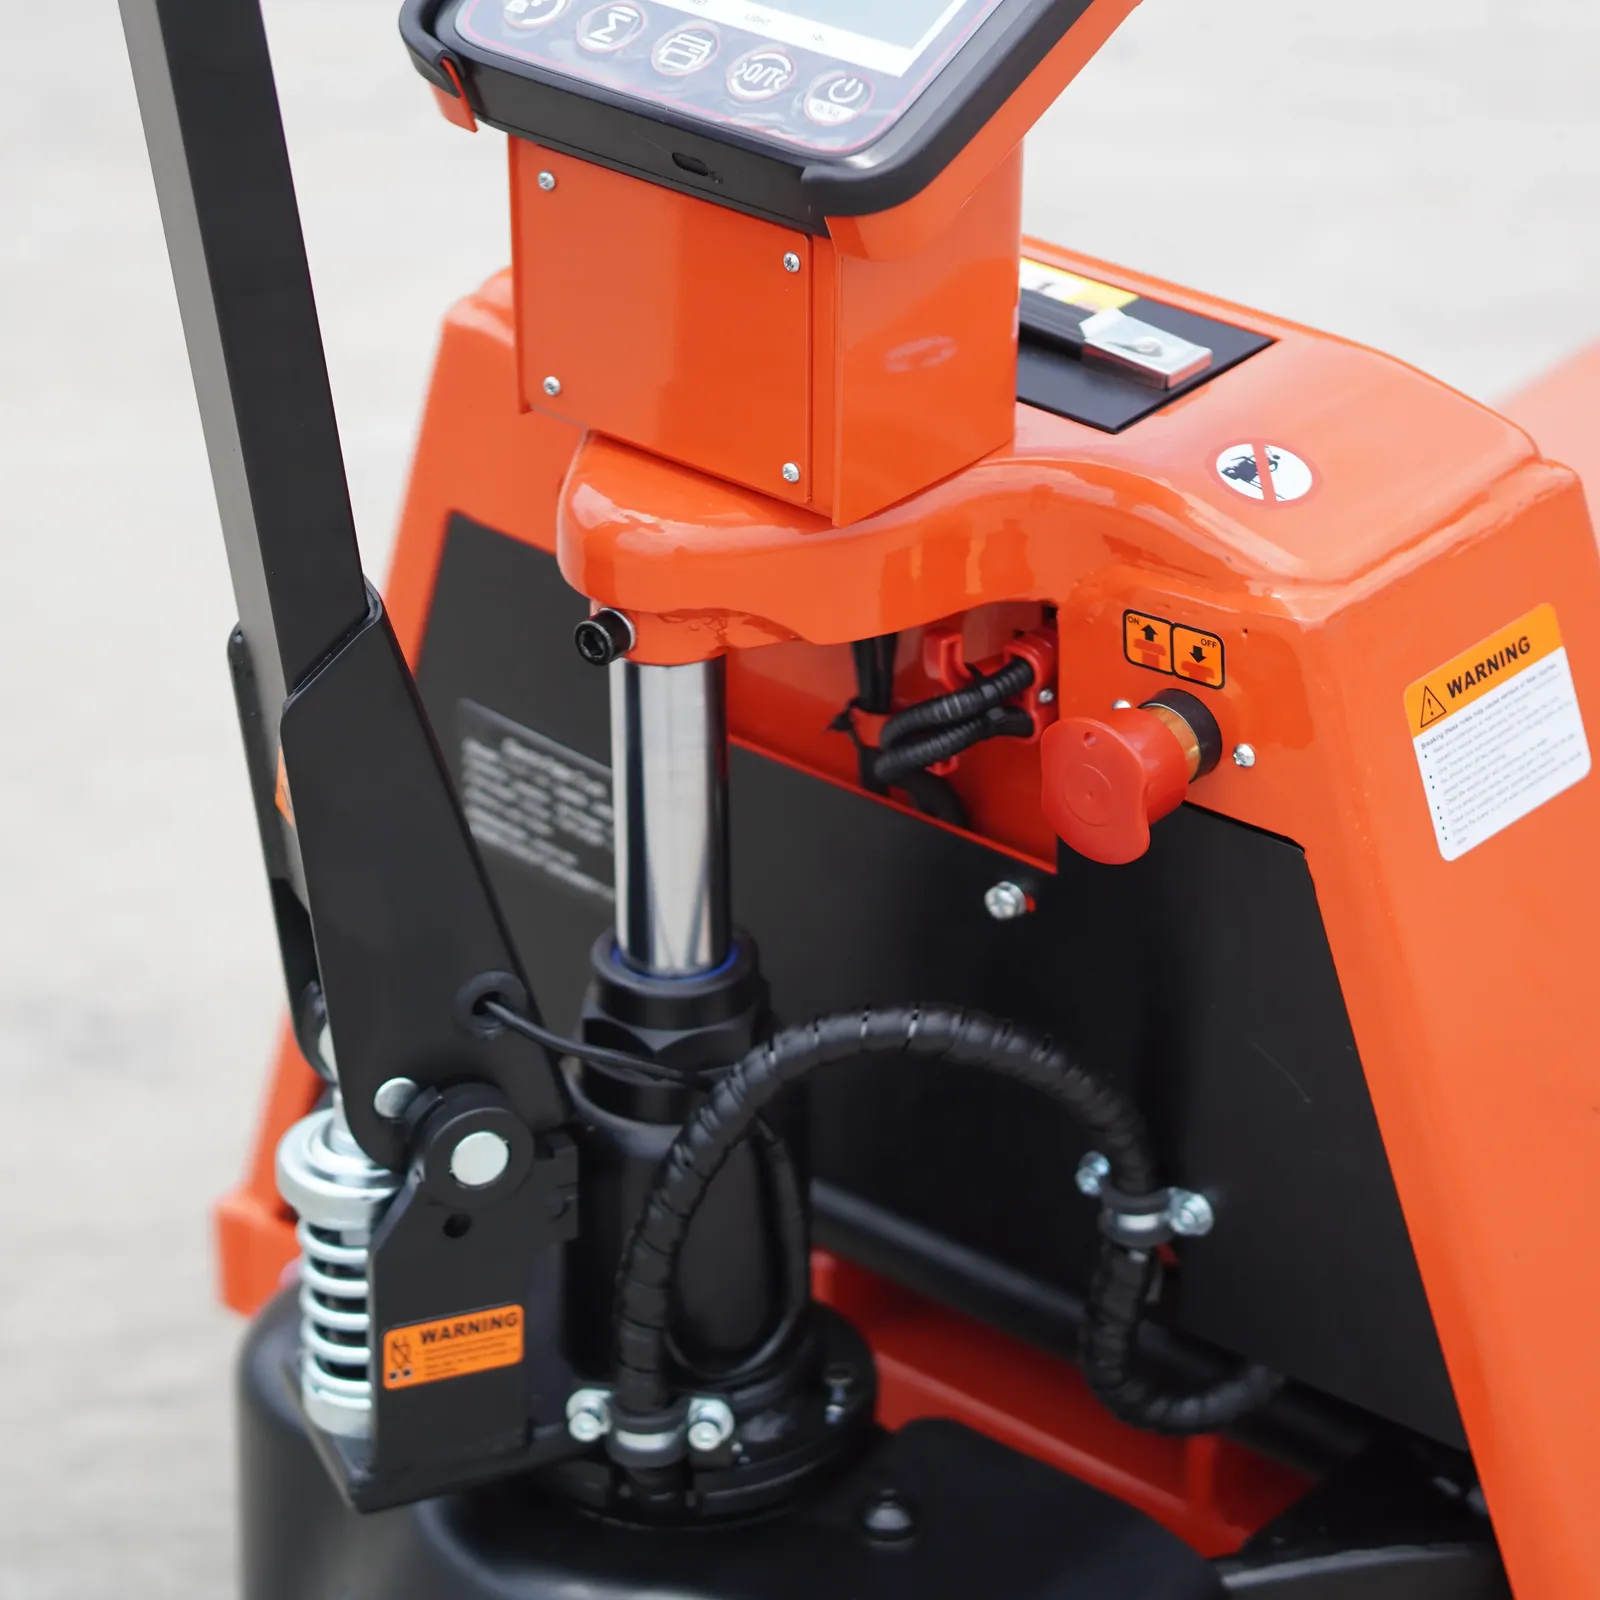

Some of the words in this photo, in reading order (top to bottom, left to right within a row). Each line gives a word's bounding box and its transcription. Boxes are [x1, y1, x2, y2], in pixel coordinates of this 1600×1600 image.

[1127, 616, 1140, 625] ON
[1200, 638, 1217, 649] OFF
[1446, 636, 1531, 699] WARNING
[420, 1312, 518, 1345] WARNING
